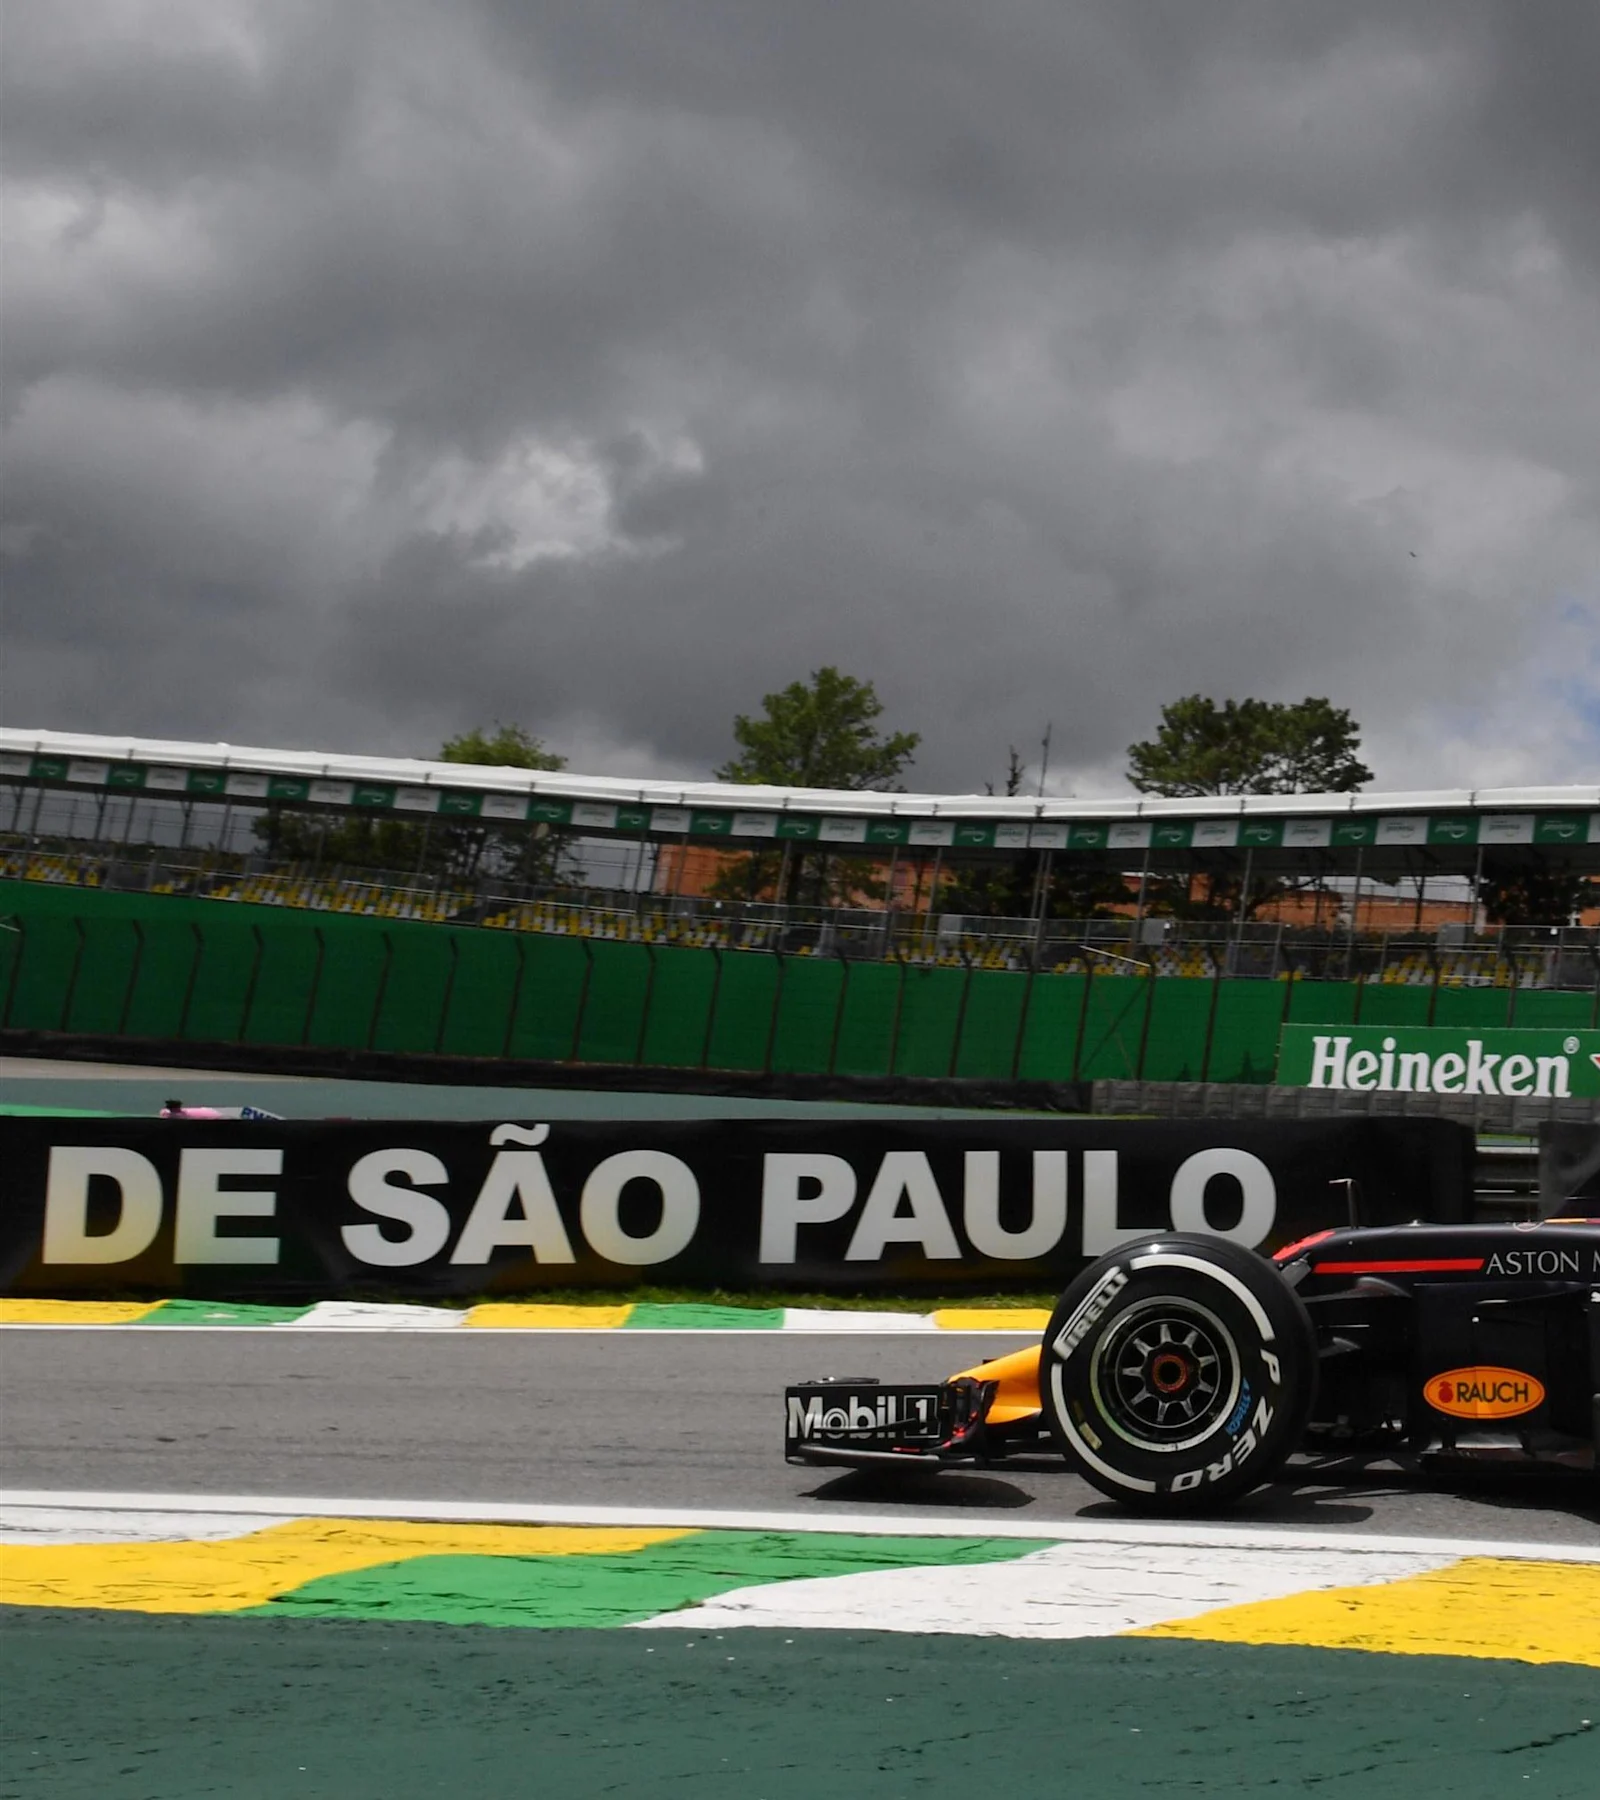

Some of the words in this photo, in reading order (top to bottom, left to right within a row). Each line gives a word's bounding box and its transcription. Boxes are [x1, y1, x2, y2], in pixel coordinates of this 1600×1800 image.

[1310, 1036, 1572, 1098] Heineken
[42, 1146, 284, 1265] DE
[340, 1123, 702, 1267] SÃO
[758, 1147, 1278, 1264] PAULO
[1486, 1250, 1580, 1276] ASTON
[1053, 1265, 1129, 1361] PIRELLI
[788, 1395, 897, 1439] Mobil
[914, 1398, 929, 1434] 1
[1456, 1381, 1529, 1404] RAUCH
[1171, 1396, 1275, 1493] ZERO
